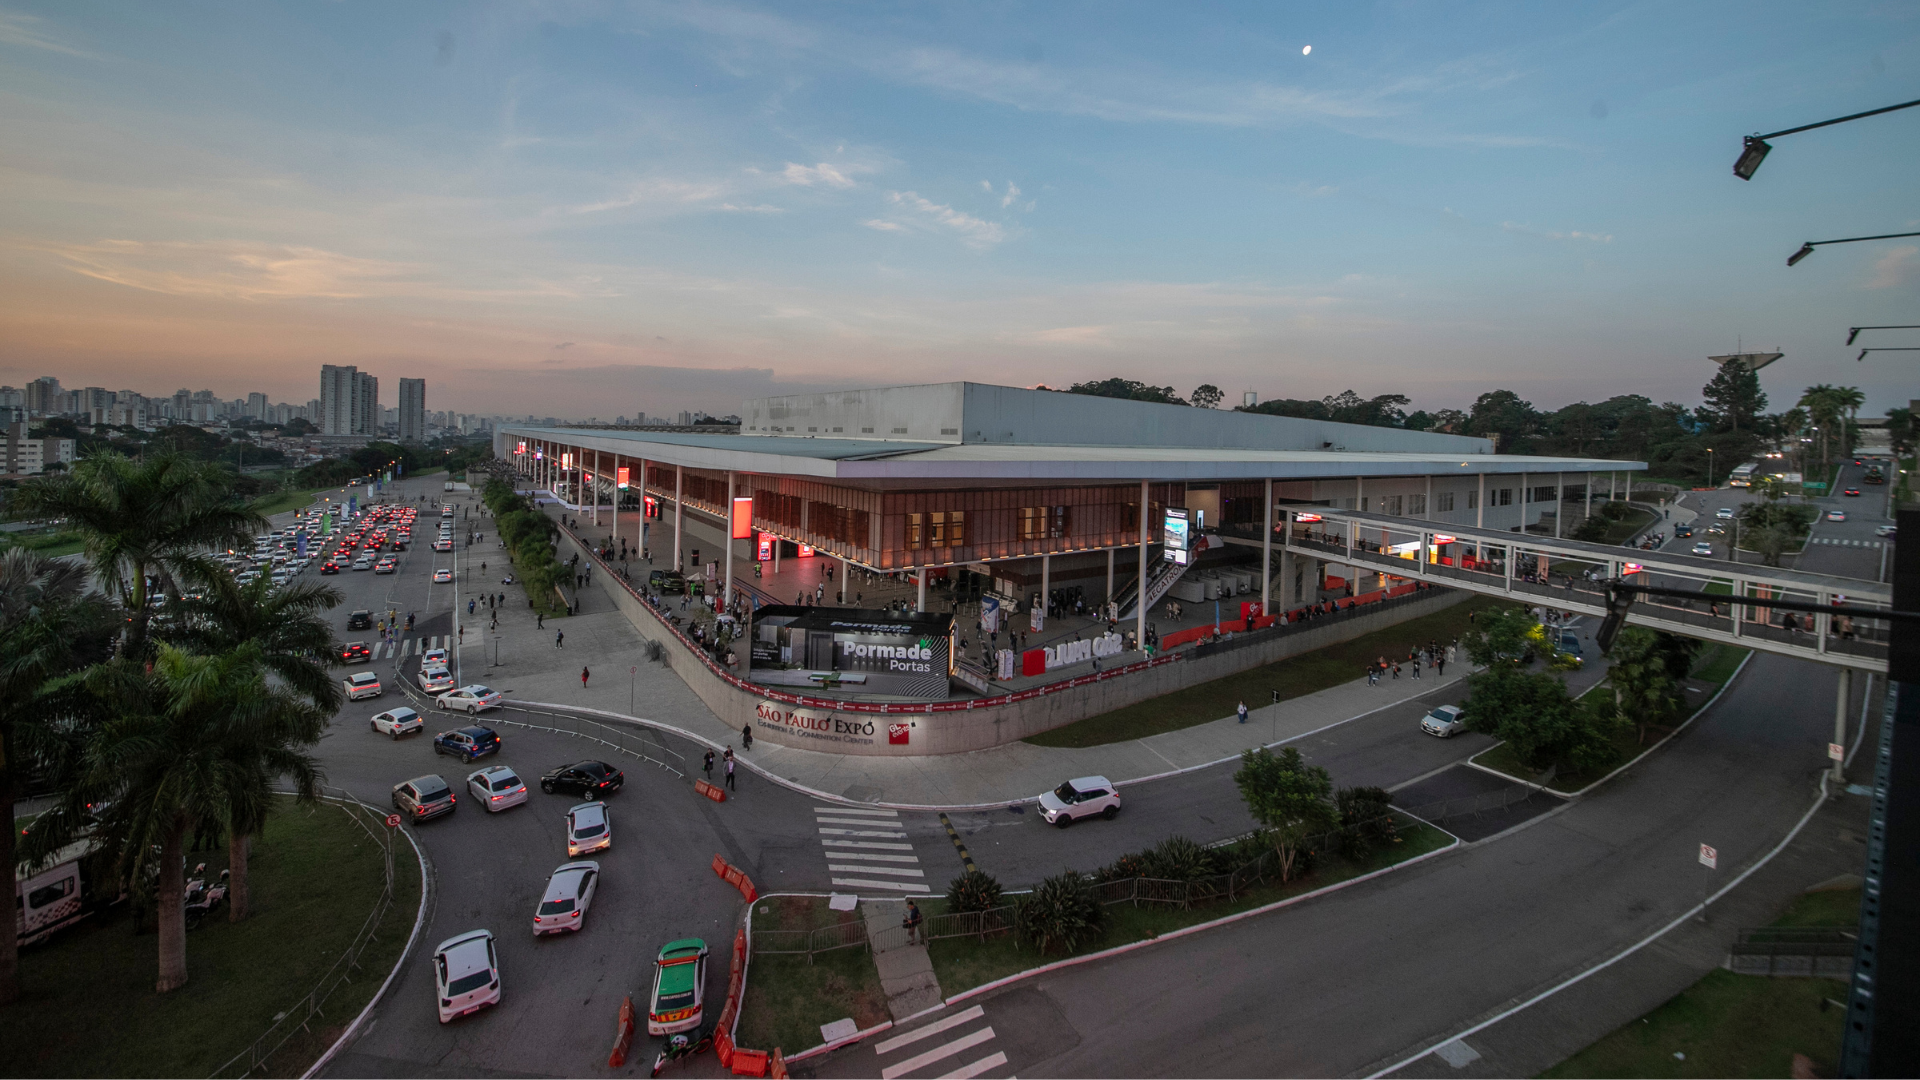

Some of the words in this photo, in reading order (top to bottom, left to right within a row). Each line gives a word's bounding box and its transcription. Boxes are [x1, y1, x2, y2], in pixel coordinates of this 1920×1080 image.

[843, 641, 932, 660] Pormade
[890, 660, 930, 672] Portas
[757, 704, 782, 722] SÃO
[785, 712, 830, 732] PAULO
[835, 720, 875, 736] EXPO
[889, 724, 902, 733] GL
